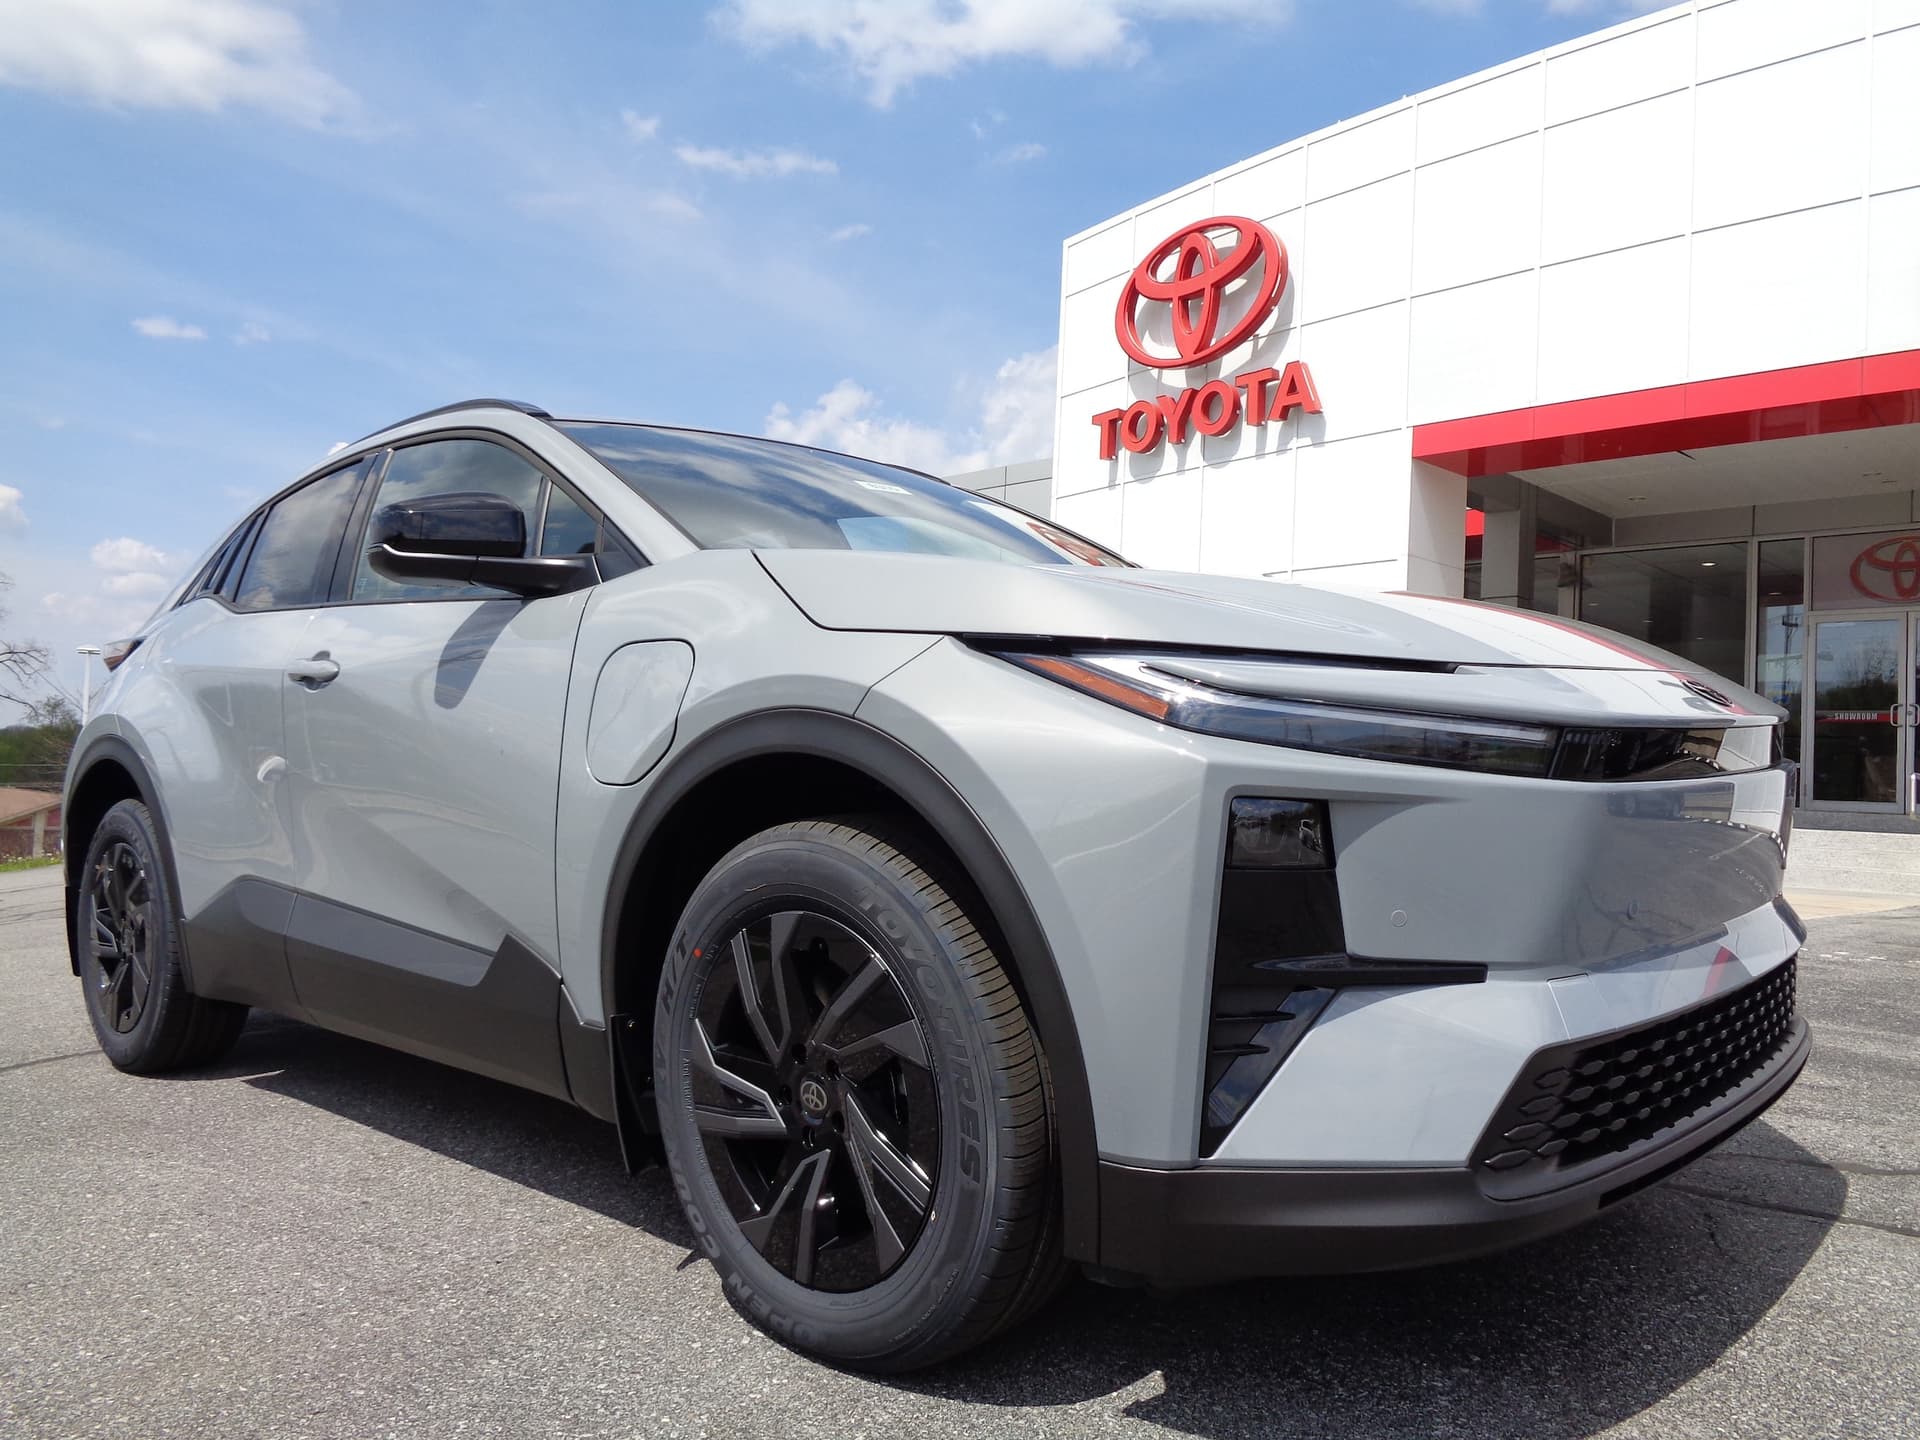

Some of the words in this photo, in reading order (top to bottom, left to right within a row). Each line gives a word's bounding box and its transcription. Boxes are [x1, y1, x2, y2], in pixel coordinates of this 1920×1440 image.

[1091, 360, 1323, 461] TOYOTA
[1834, 711, 1878, 721] SHOWROOM
[660, 929, 688, 1016] H/T
[859, 883, 945, 1003] TOYO
[937, 1004, 982, 1185] TIRES
[725, 1265, 822, 1346] OPEN
